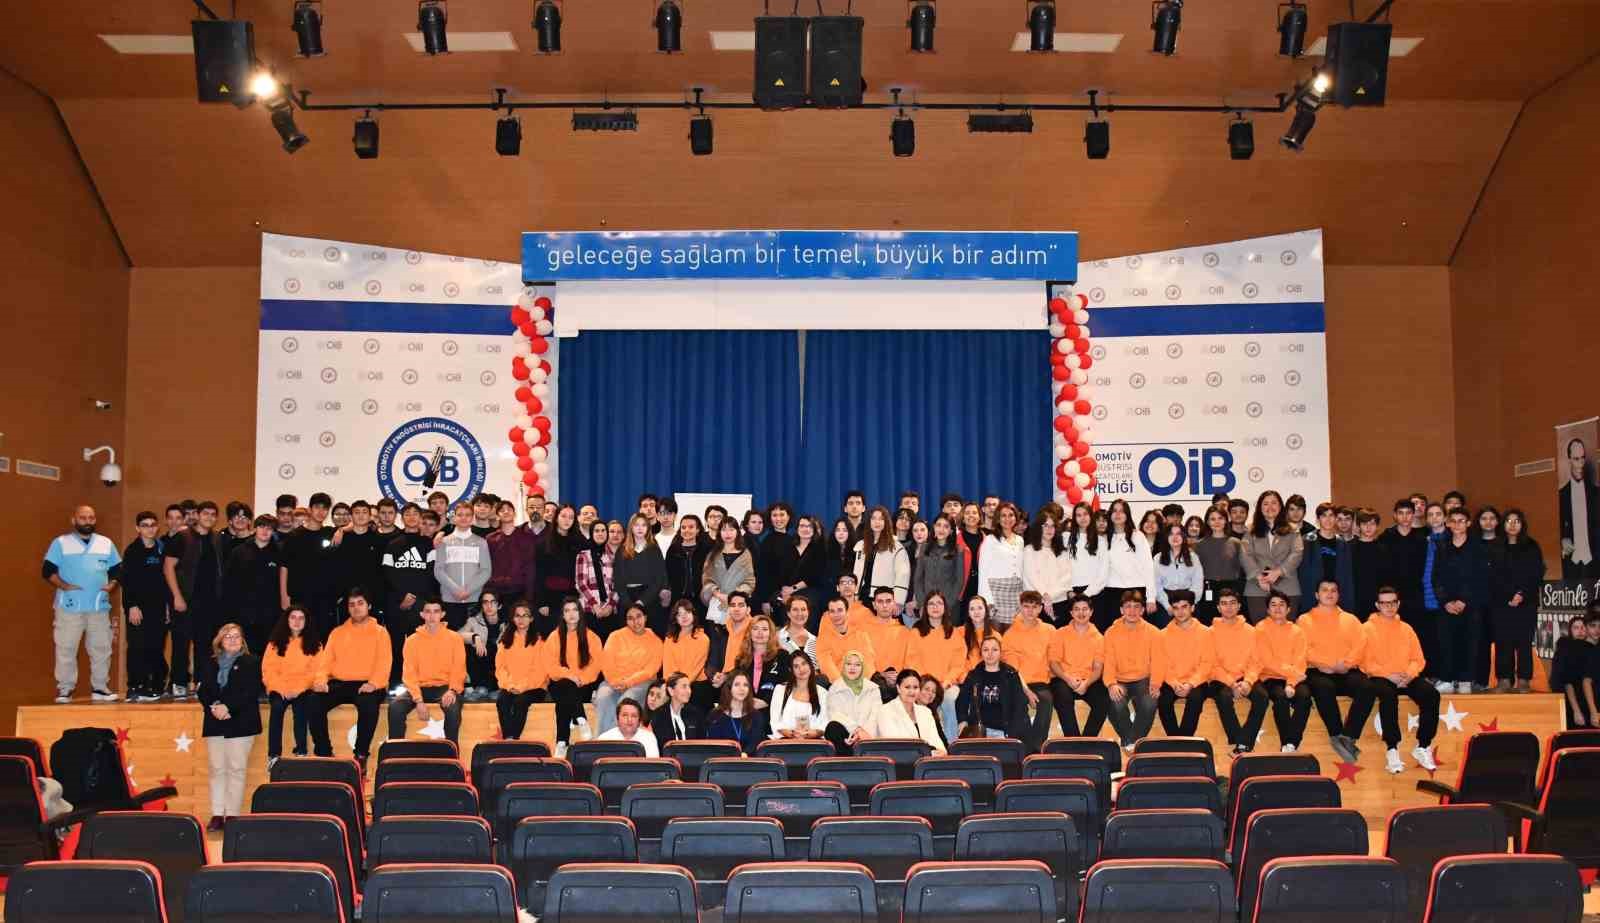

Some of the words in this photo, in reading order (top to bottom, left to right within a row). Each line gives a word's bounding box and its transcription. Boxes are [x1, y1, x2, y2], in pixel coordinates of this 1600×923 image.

[660, 243, 746, 271] sağlam
[755, 243, 786, 264] bir
[793, 244, 867, 267] temel,
[875, 243, 944, 270] büyük
[952, 243, 984, 265] bir
[1095, 450, 1132, 461] OMOTİV
[394, 559, 427, 570] adidas
[1543, 583, 1588, 607] Seninle
